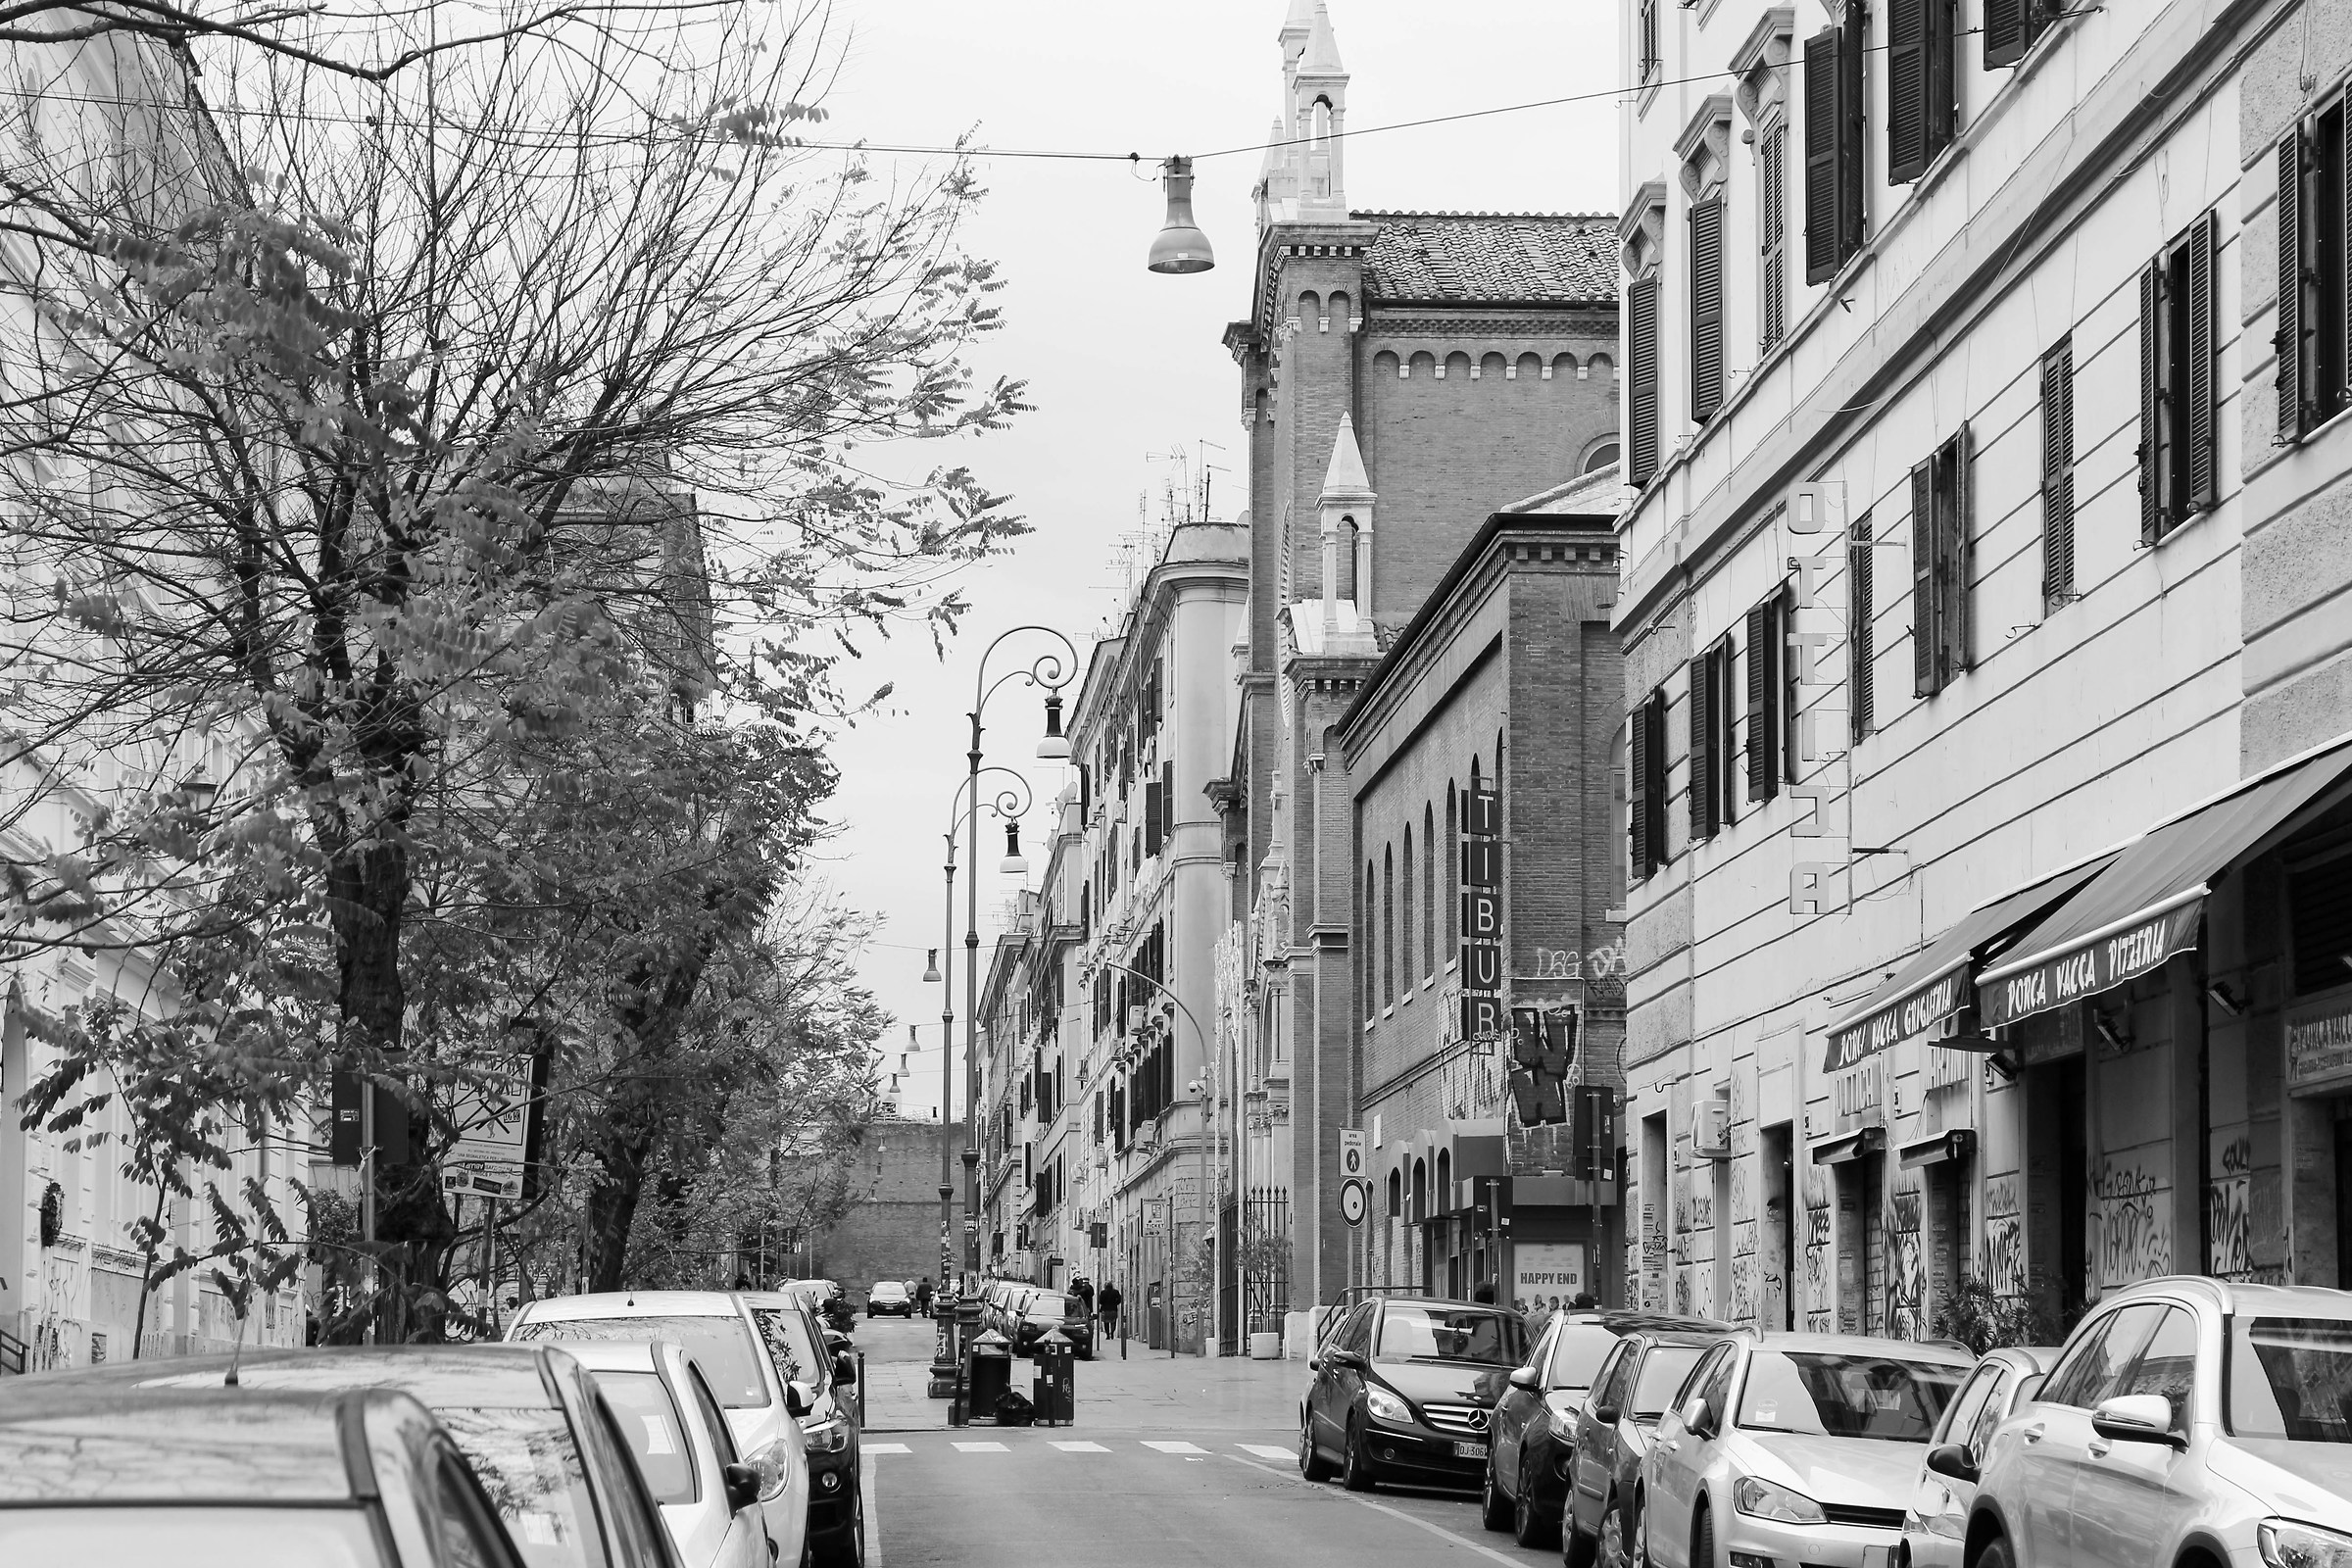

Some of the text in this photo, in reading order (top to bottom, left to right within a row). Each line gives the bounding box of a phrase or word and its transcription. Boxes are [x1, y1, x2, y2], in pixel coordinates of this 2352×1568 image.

[1476, 794, 1495, 1037] TIBUR
[2007, 918, 2166, 1019] PORCA VACCA PIZZERIA
[1520, 1272, 1578, 1285] HAPPY END
